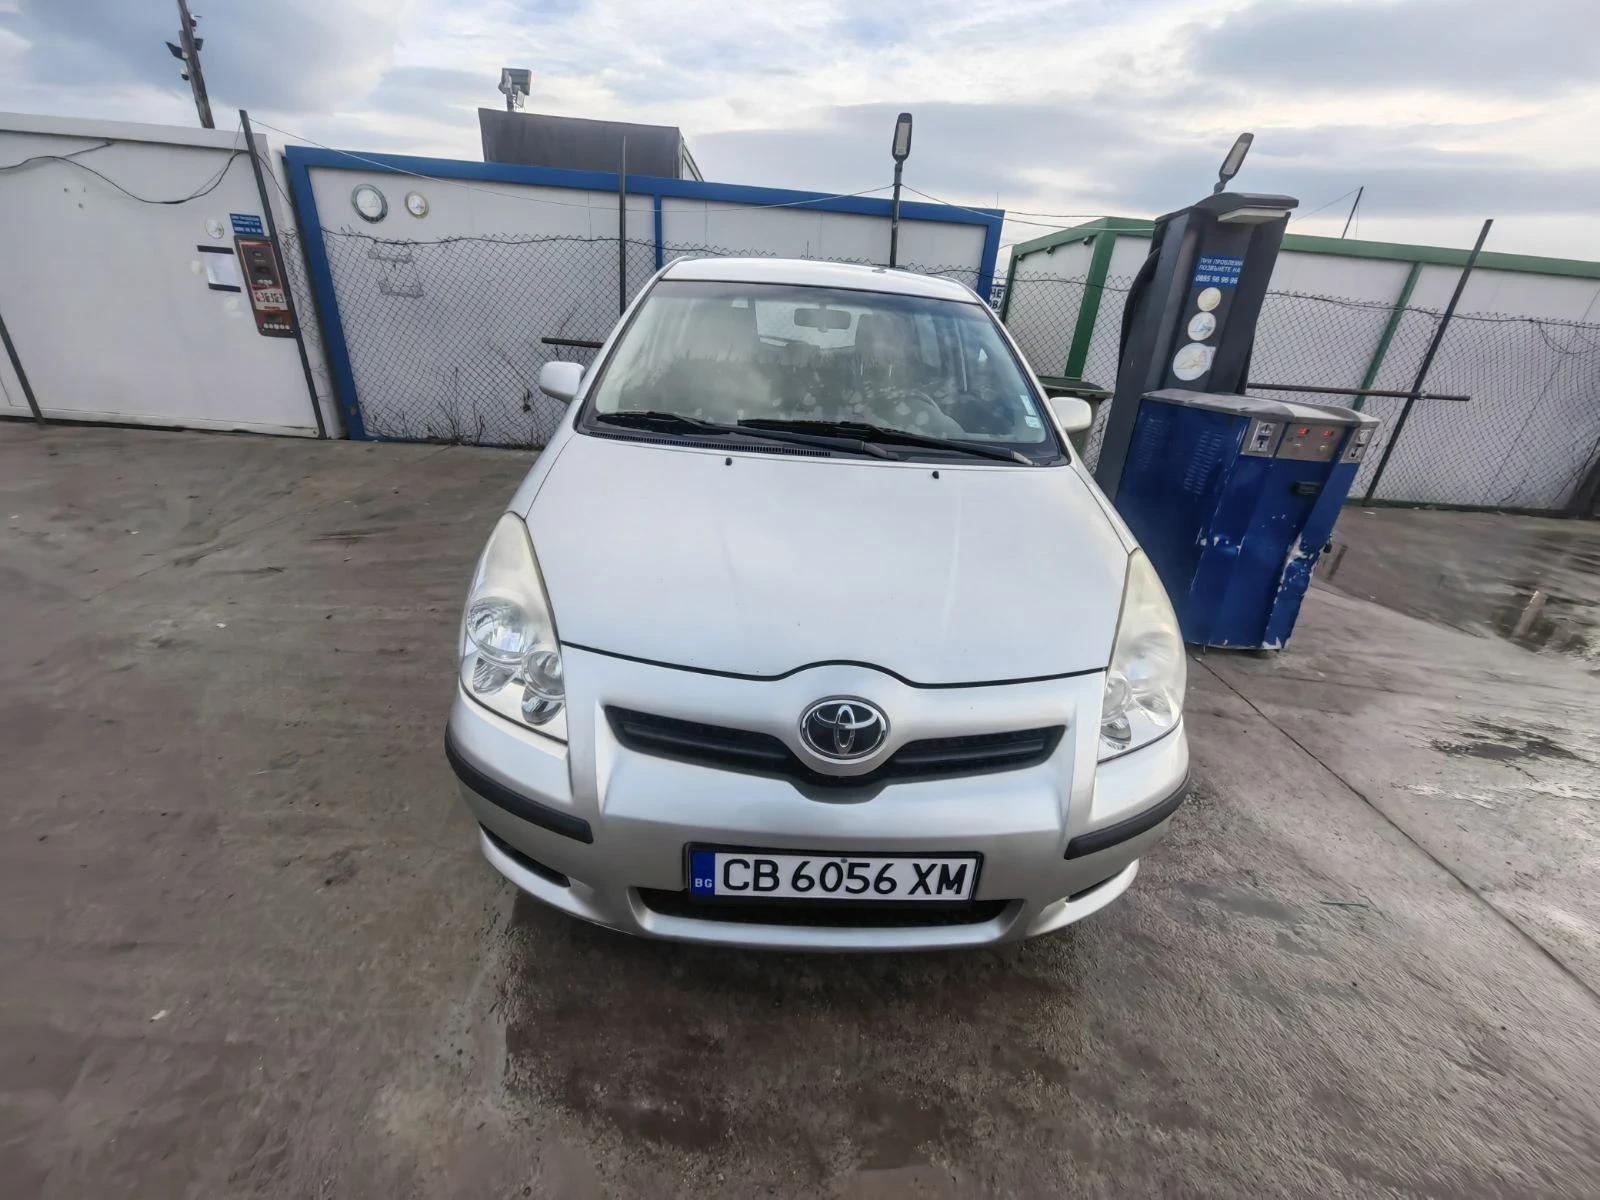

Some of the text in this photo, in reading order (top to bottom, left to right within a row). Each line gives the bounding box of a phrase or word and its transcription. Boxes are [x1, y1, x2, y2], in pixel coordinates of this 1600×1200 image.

[694, 858, 968, 895] BG CB 6056 XM
